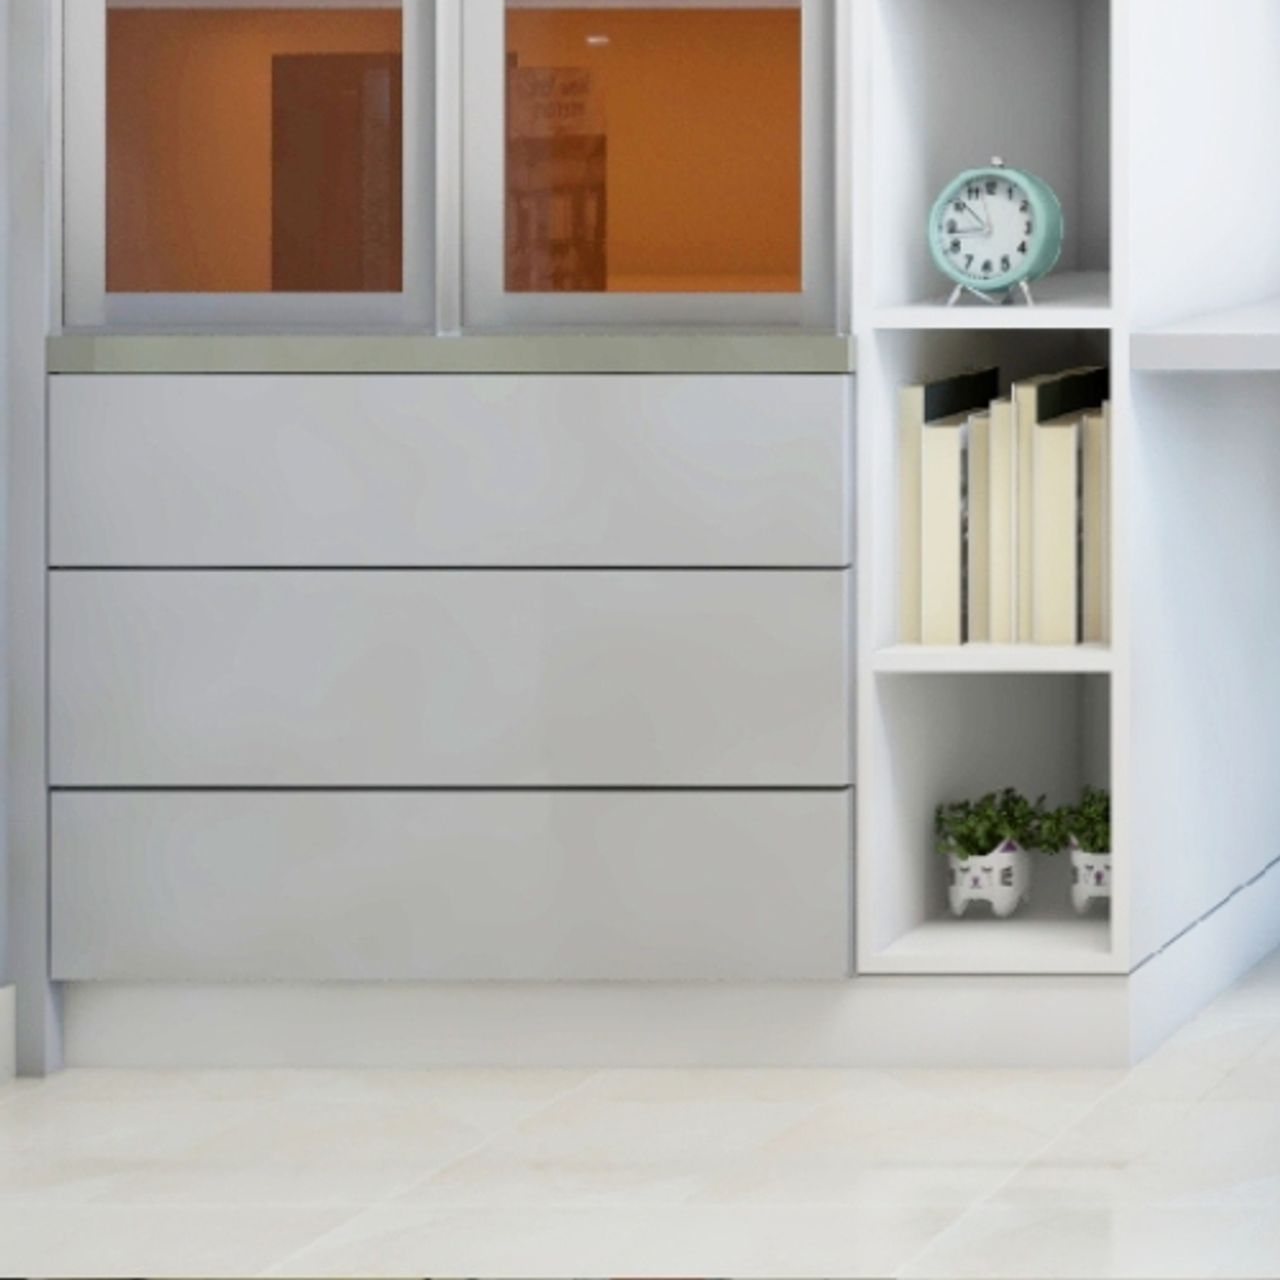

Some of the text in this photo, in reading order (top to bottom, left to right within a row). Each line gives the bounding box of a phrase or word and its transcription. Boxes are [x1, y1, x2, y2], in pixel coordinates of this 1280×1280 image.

[967, 187, 979, 200] 11
[1007, 187, 1013, 200] 1
[1019, 200, 1029, 213] 2
[1017, 241, 1026, 255] 4
[965, 254, 974, 270] 7
